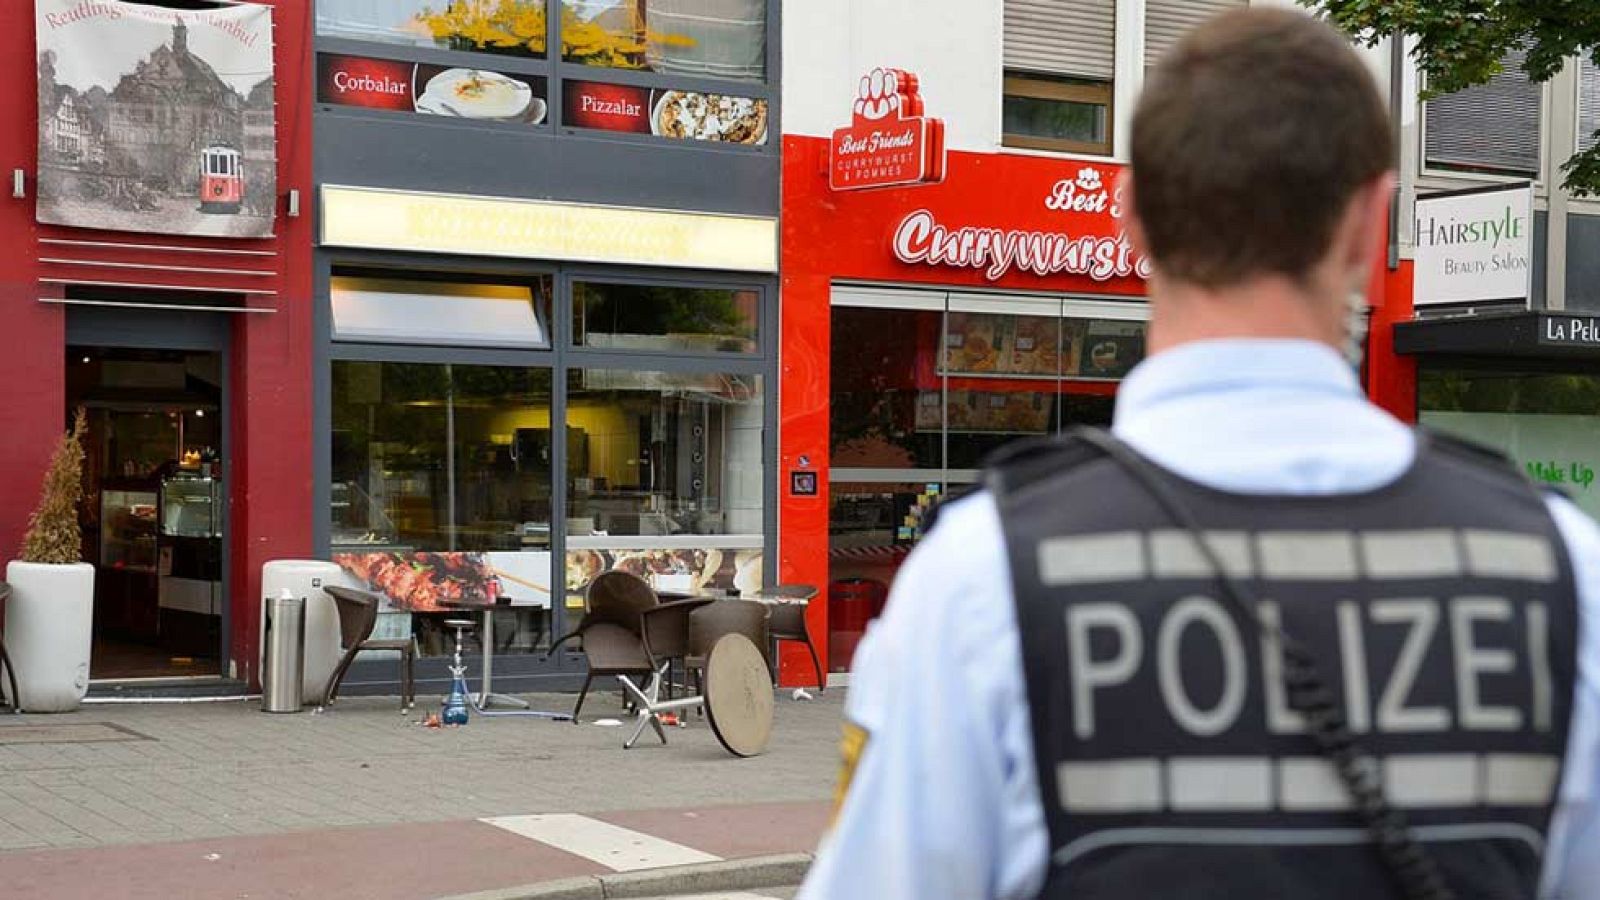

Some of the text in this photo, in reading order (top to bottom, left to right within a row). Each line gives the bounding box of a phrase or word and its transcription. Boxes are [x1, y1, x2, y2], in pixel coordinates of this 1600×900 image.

[45, 0, 135, 29] Reutling
[333, 71, 407, 95] Çorbalar
[581, 95, 641, 117] Pizzalar
[838, 128, 914, 155] Best Friends
[837, 152, 914, 171] CURRYWURST
[855, 165, 901, 179] POMMES
[1044, 179, 1108, 213] Best
[892, 208, 1134, 281] Currywurst
[1572, 461, 1595, 490] Up
[1065, 595, 1552, 741] POLIZEI
